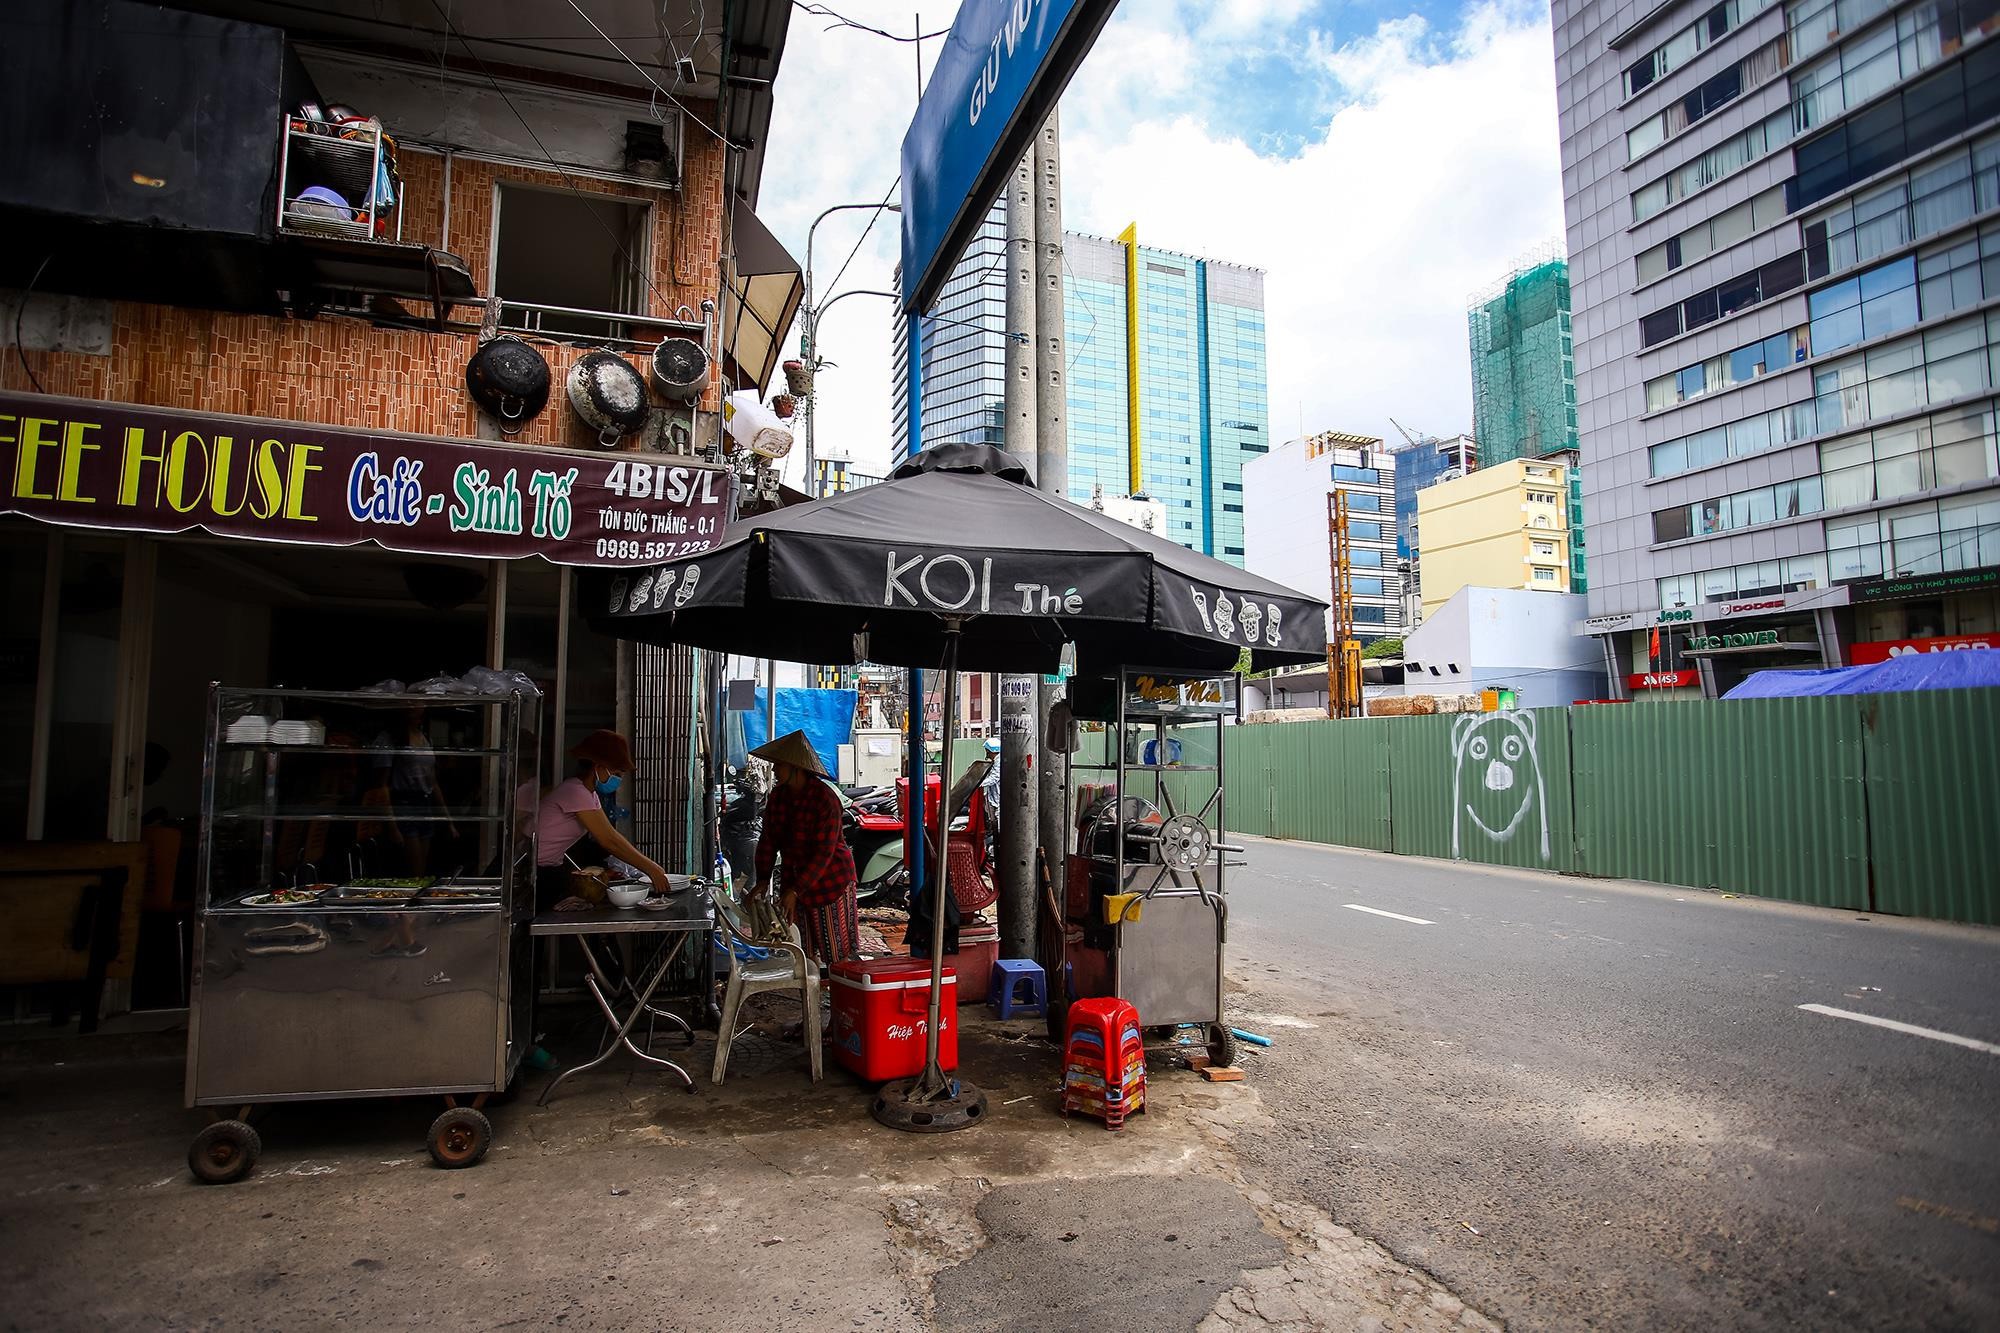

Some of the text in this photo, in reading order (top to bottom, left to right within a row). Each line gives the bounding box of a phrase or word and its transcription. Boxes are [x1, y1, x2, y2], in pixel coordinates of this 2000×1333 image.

[117, 426, 324, 522] HOUSE
[604, 461, 719, 507] 4BIS/L
[347, 451, 424, 526] Café
[449, 461, 523, 536] Sinh
[529, 467, 579, 540] Tố
[599, 505, 621, 530] TÔN
[624, 508, 648, 533] ĐỨC
[651, 509, 688, 535] THẮNG
[697, 516, 716, 536] Q.1
[596, 538, 711, 560] 0989.587.223
[884, 551, 1084, 615] KOI Thé
[1656, 609, 1693, 623] Jeep
[1732, 600, 1786, 613] DODGE
[1688, 630, 1779, 650] VFC TOWER
[1658, 674, 1678, 684] MSB
